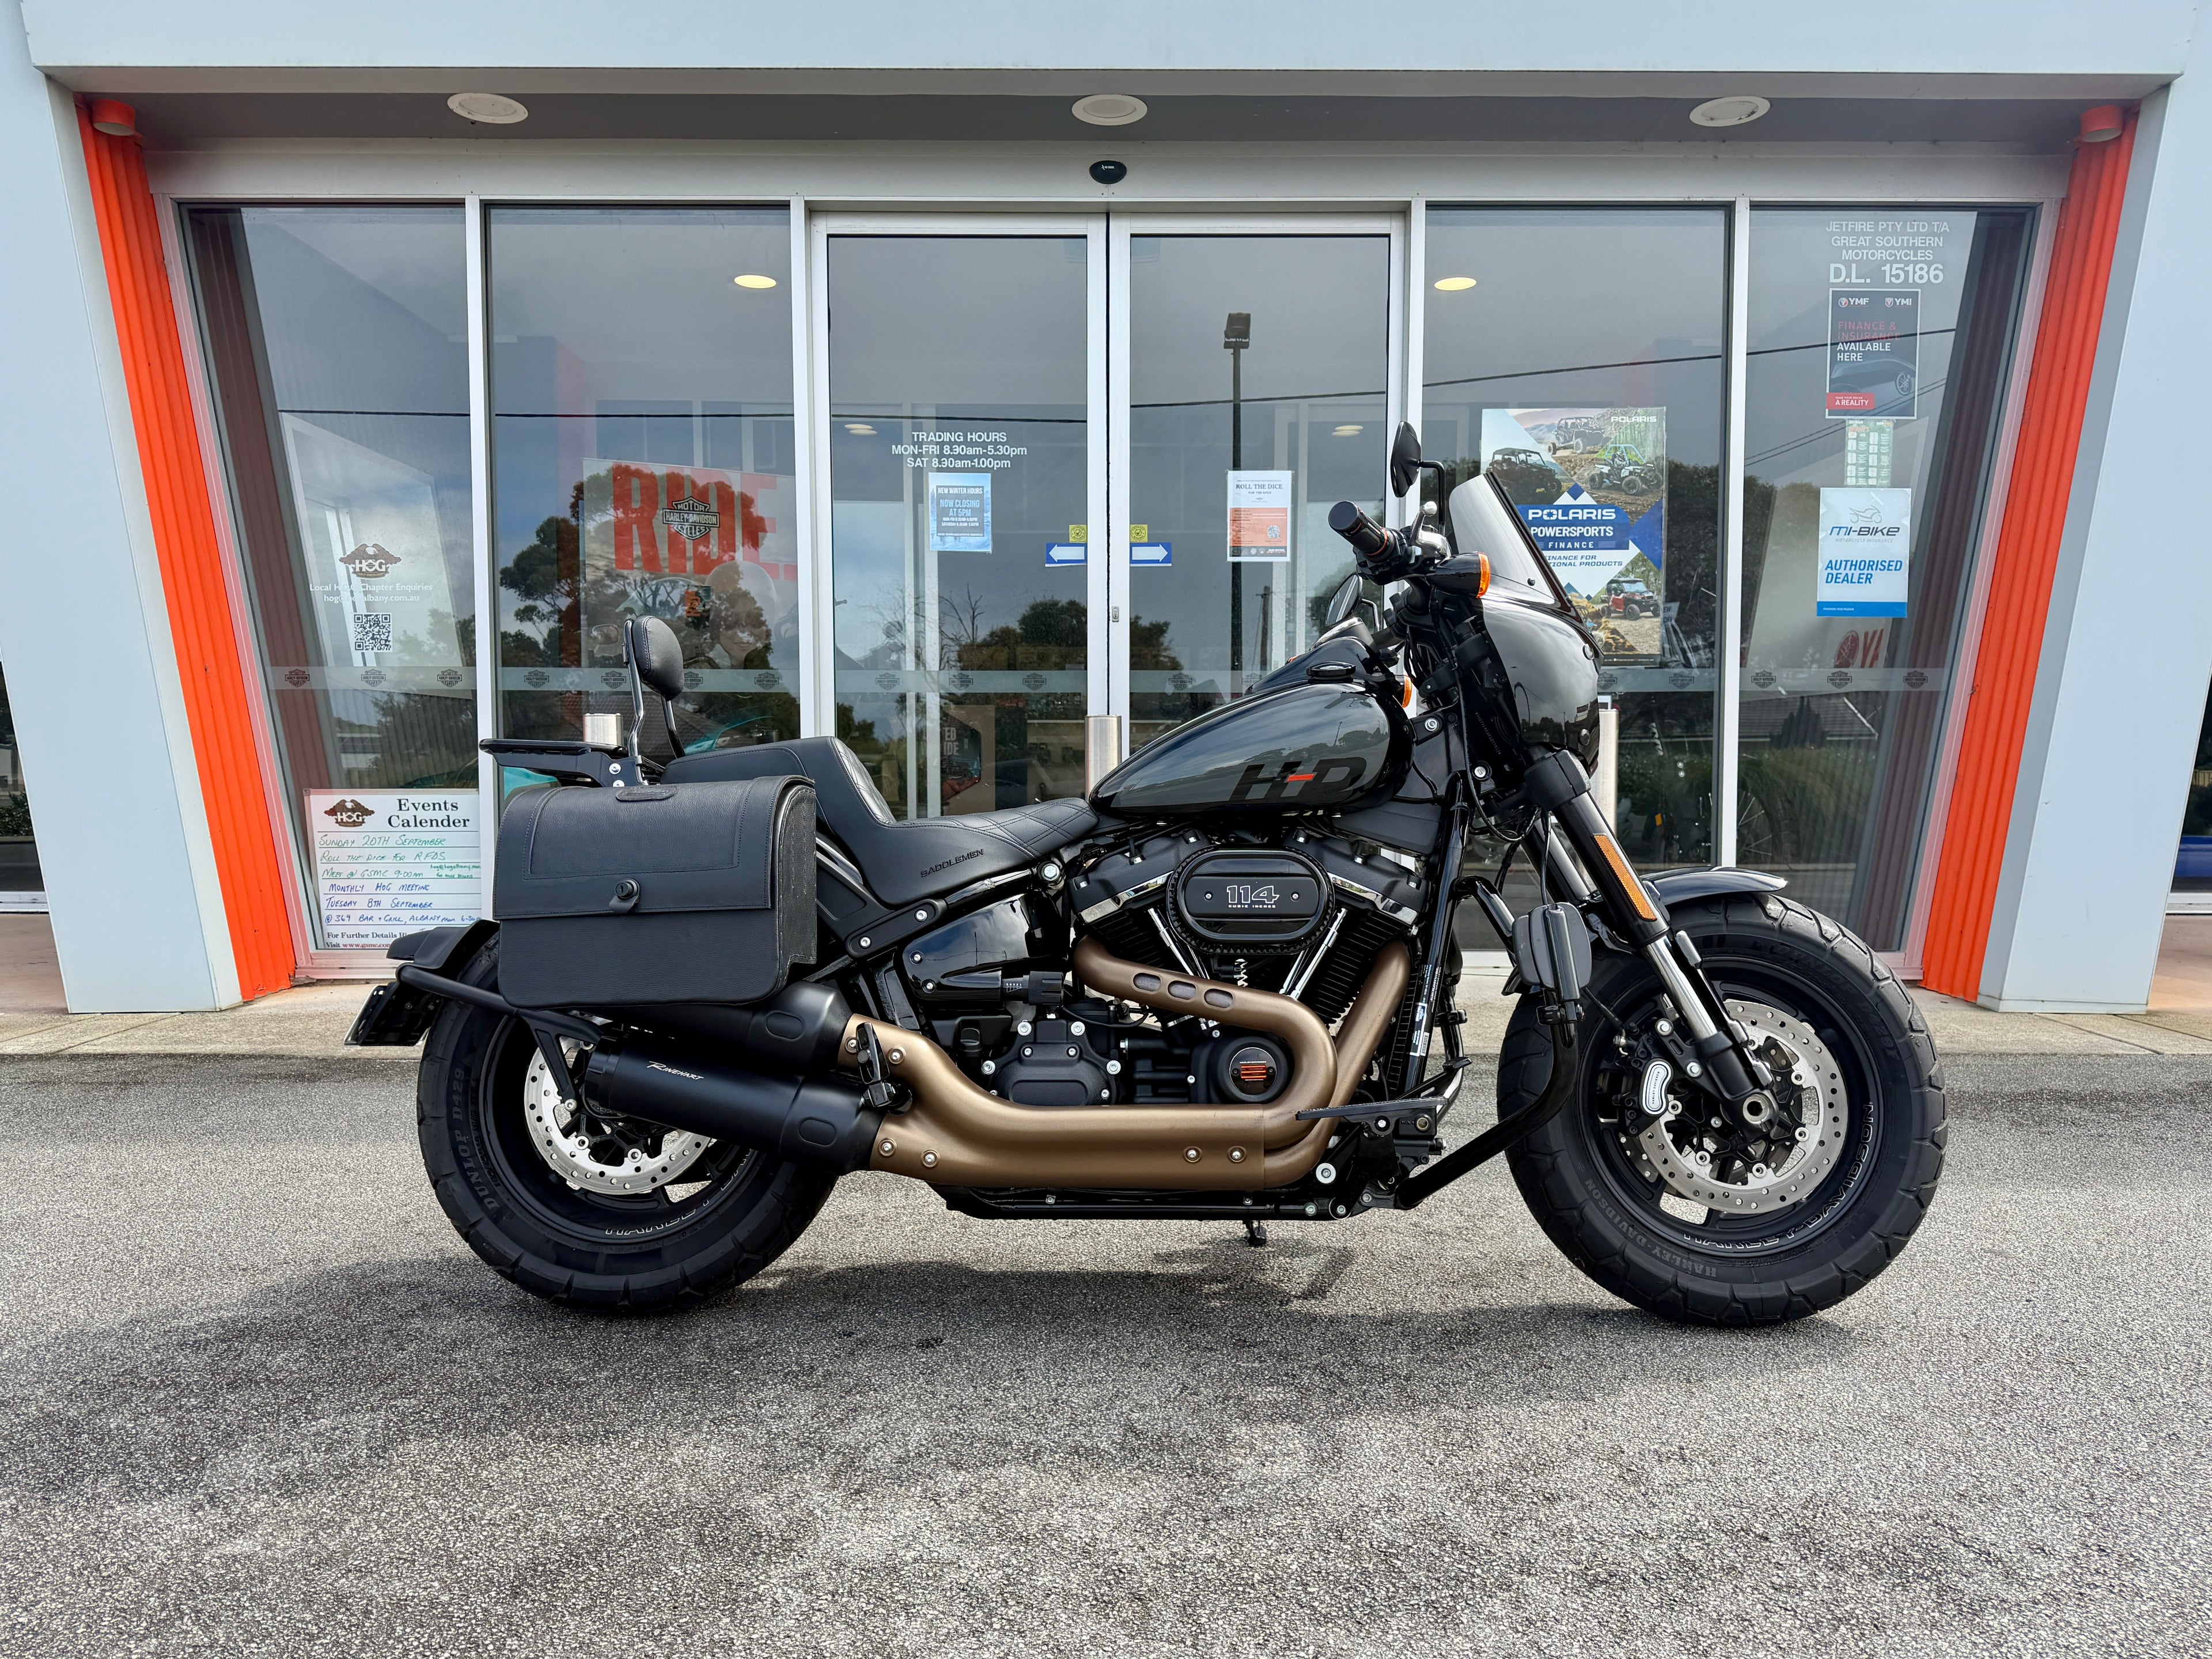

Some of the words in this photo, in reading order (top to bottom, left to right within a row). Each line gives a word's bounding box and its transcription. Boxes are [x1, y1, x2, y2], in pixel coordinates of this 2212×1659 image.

[1826, 221, 1874, 232] JETFIRE
[1878, 221, 1903, 232] PTY
[1907, 221, 1928, 232] LTD
[1932, 221, 1949, 233] T/A
[1831, 236, 1872, 247] GREAT
[1875, 236, 1943, 247] SOUTHERN
[1842, 249, 1933, 260] MOTORCYCLES
[1830, 263, 1871, 283] D.L.
[1881, 263, 1944, 283] 15186
[1849, 297, 1869, 305] YMF
[1838, 321, 1885, 330] FINANCE
[1889, 321, 1896, 330] &
[1838, 332, 1900, 341] INSURANCE
[1836, 342, 1891, 351] AVAILABLE
[1836, 353, 1863, 362] HERE
[912, 432, 964, 442] TRADING
[967, 432, 1007, 442] HOURS
[892, 445, 940, 455] MON-FRI
[907, 457, 929, 468] SAT
[677, 500, 704, 511] MOTOR
[955, 499, 980, 507] CLOSING
[666, 512, 717, 525] HARLEY-DAVIDSON
[949, 509, 957, 517] AT
[958, 509, 971, 517] 5PM
[1528, 509, 1616, 520] POLARIS
[679, 525, 705, 537] CYCLES
[1530, 527, 1613, 537] POWERSPORTS
[355, 559, 386, 572] HOG
[1825, 559, 1903, 571] AUTHORISED
[1825, 573, 1873, 584] DEALER
[309, 583, 331, 591] Local
[361, 583, 393, 593] Chapter
[396, 583, 433, 593] Enquiries
[397, 798, 459, 811] Events
[337, 812, 363, 822] HOG
[388, 815, 470, 828] Calender
[362, 835, 390, 846] 20TH
[920, 849, 984, 877] SADDLEMEN
[328, 883, 364, 892] MONTHLY
[398, 884, 430, 892] MEETING
[1226, 885, 1280, 903] 114
[326, 897, 357, 908] TUESDAY
[367, 899, 381, 908] 8TH
[390, 897, 433, 908] SEPTEMBER
[358, 914, 374, 922] BAR
[646, 1060, 704, 1081] RINEHART
[454, 1128, 500, 1210] DUNLOP
[1584, 1177, 1718, 1278] HARLEY-DAVIDSON
